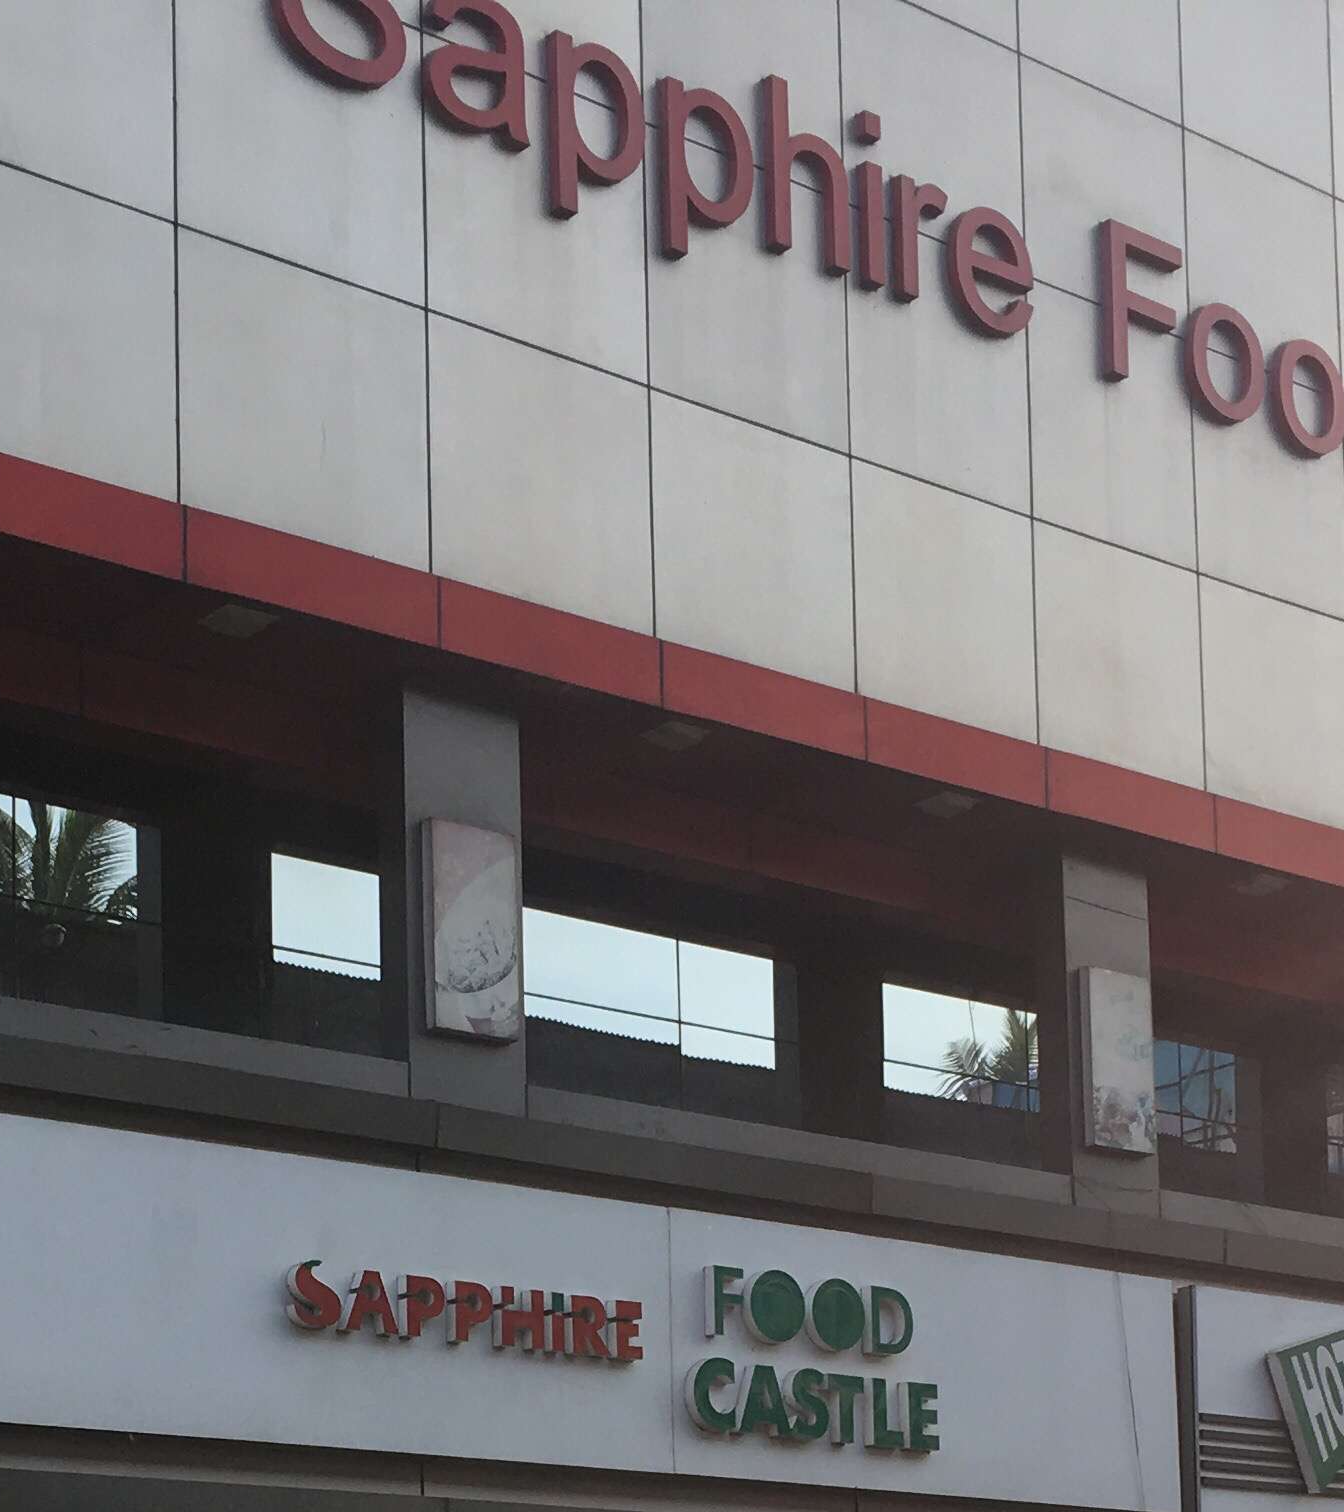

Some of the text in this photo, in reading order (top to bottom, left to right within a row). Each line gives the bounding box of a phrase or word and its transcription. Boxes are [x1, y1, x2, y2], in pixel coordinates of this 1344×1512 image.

[285, 1259, 644, 1362] SAPPHIRE
[703, 1264, 914, 1357] FOOD
[684, 1356, 941, 1454] CASTLE
